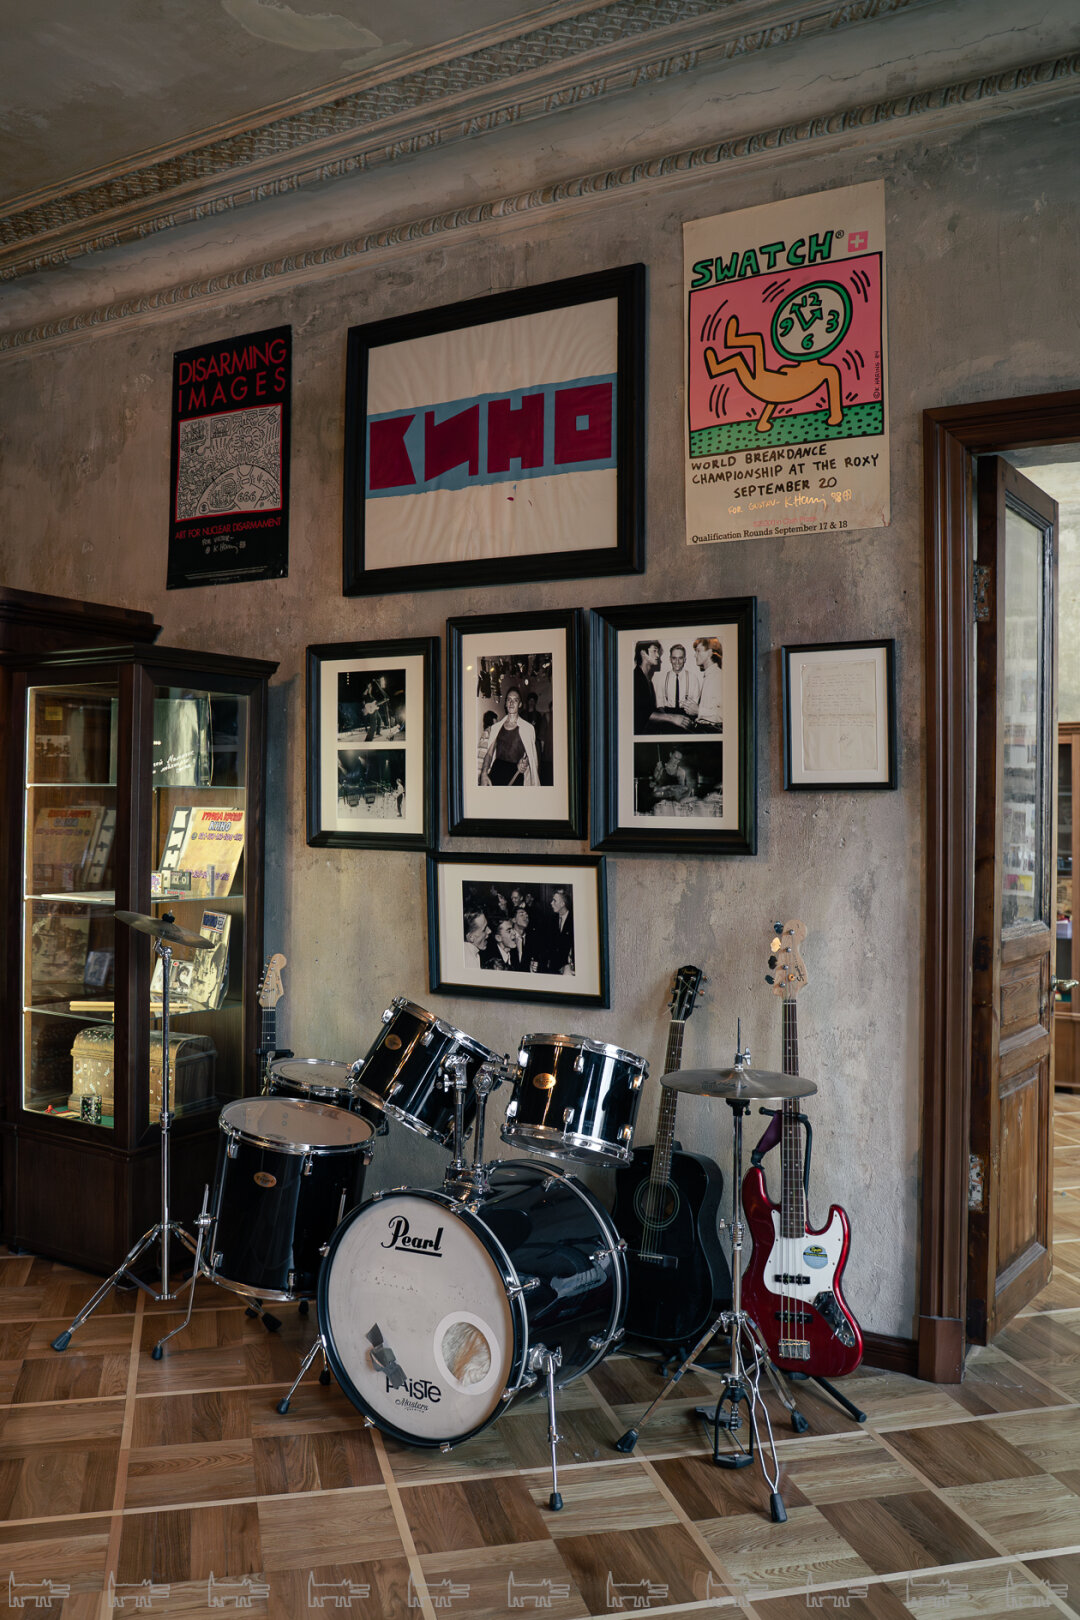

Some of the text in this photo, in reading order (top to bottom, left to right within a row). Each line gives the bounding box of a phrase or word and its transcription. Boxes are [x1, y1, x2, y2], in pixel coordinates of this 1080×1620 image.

[691, 230, 834, 288] SWATCH
[826, 310, 840, 333] 3
[801, 333, 814, 350] 6
[179, 339, 287, 385] DISARMING
[178, 367, 286, 413] IMAGES
[369, 382, 613, 490] КИНО
[691, 444, 827, 471] WORLD BREAKDANCE
[692, 453, 880, 485] CHAMPIONSHIP AT THE ROXY
[734, 476, 838, 499] SEPTEMBER 20
[175, 517, 282, 540] ART FOR NUCLEAR DISARMAMENT
[691, 528, 742, 544] Qualification
[743, 526, 773, 537] Rounds
[774, 521, 818, 536] September
[819, 522, 828, 530] 17
[839, 520, 848, 529] 18
[381, 1215, 444, 1251] Pearl
